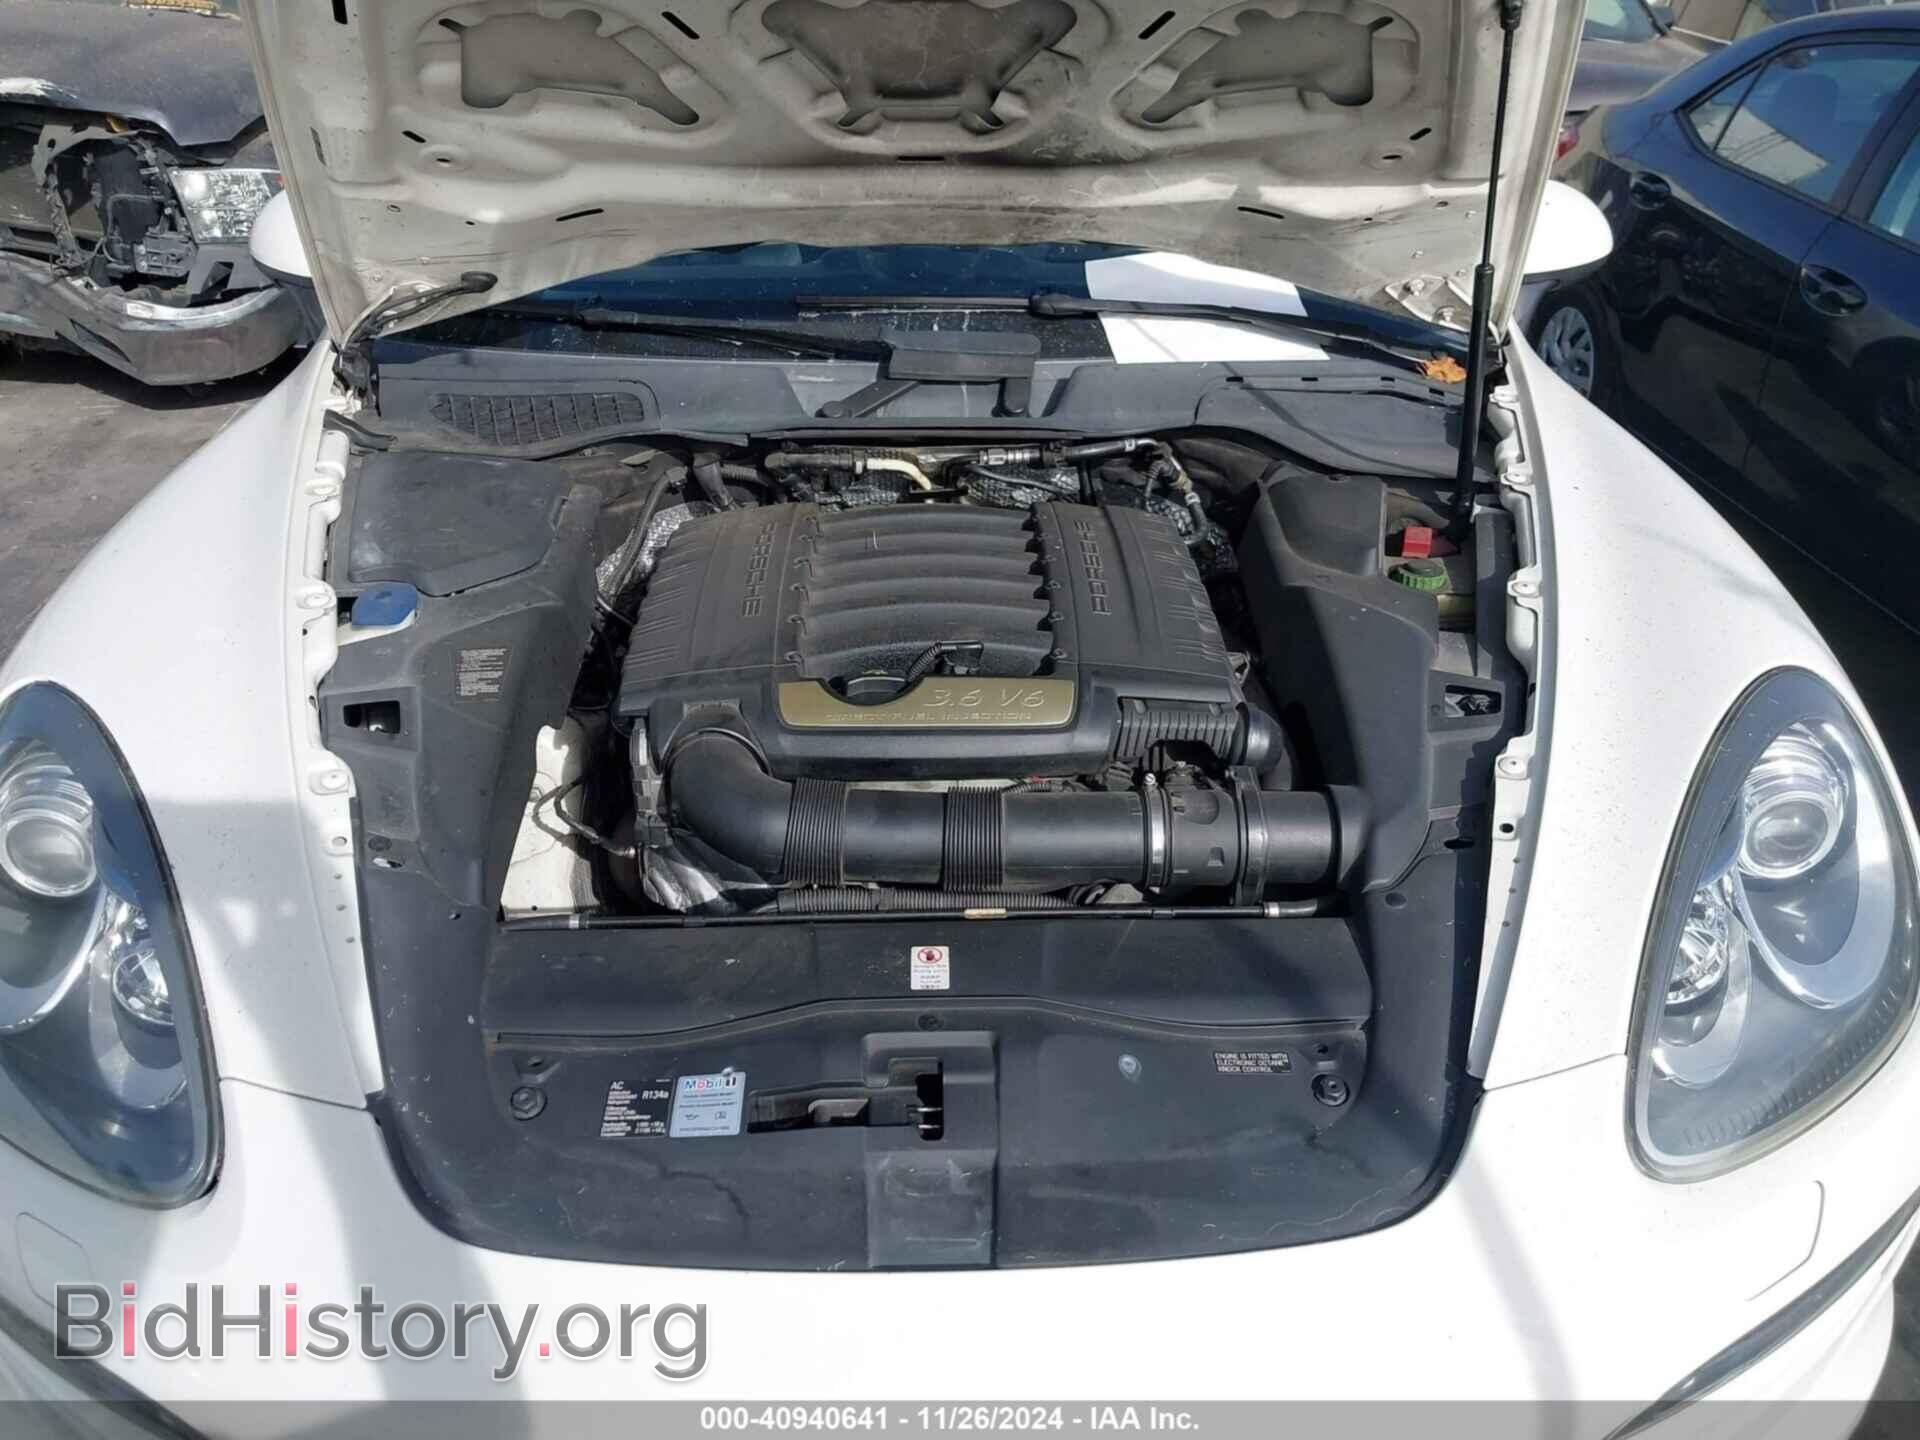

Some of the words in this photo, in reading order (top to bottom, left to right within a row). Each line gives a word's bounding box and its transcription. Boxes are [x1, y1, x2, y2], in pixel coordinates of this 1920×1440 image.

[741, 521, 777, 617] PORSCHE
[1073, 518, 1112, 616] PORSCHE
[923, 687, 983, 708] 3.6
[998, 687, 1046, 708] V6
[610, 1080, 624, 1090] AC
[684, 1079, 722, 1089] Mobil
[641, 1089, 670, 1100] R134a
